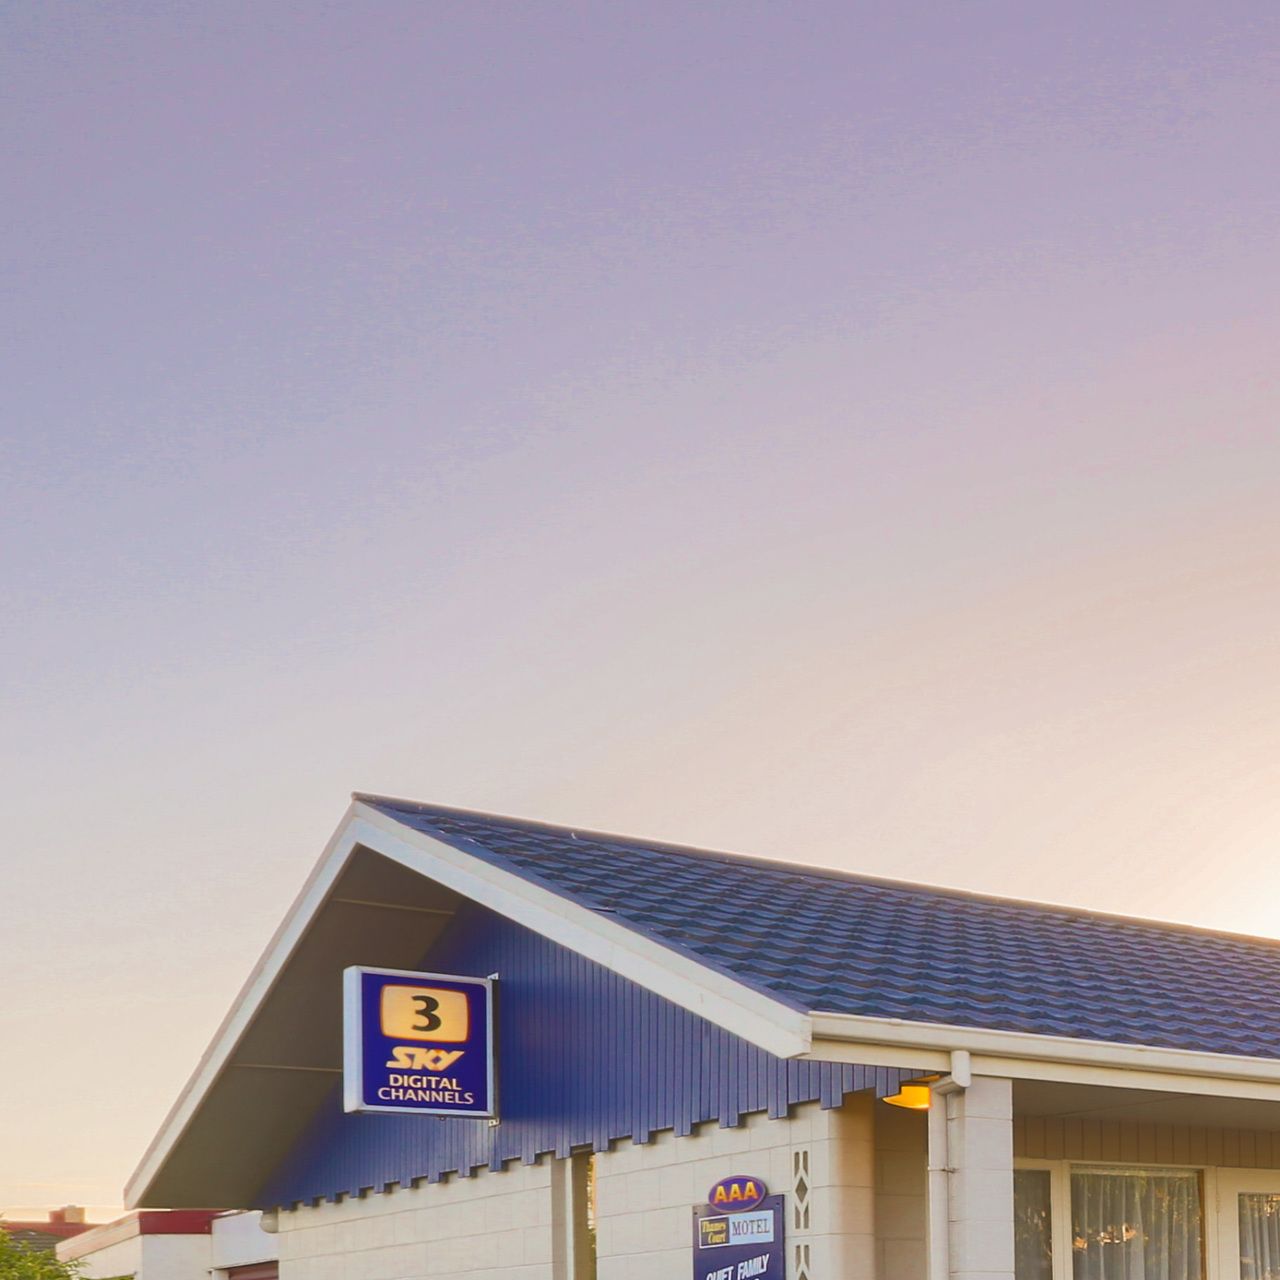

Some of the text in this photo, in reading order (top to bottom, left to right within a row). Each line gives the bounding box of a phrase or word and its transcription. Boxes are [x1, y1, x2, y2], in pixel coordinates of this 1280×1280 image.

[411, 995, 442, 1032] 3
[385, 1046, 465, 1072] SKY
[389, 1074, 462, 1091] DIGITAL
[377, 1087, 474, 1105] CHANNELS
[714, 1181, 759, 1204] AAA
[732, 1218, 770, 1236] MOTEL
[737, 1253, 770, 1280] FAMILY
